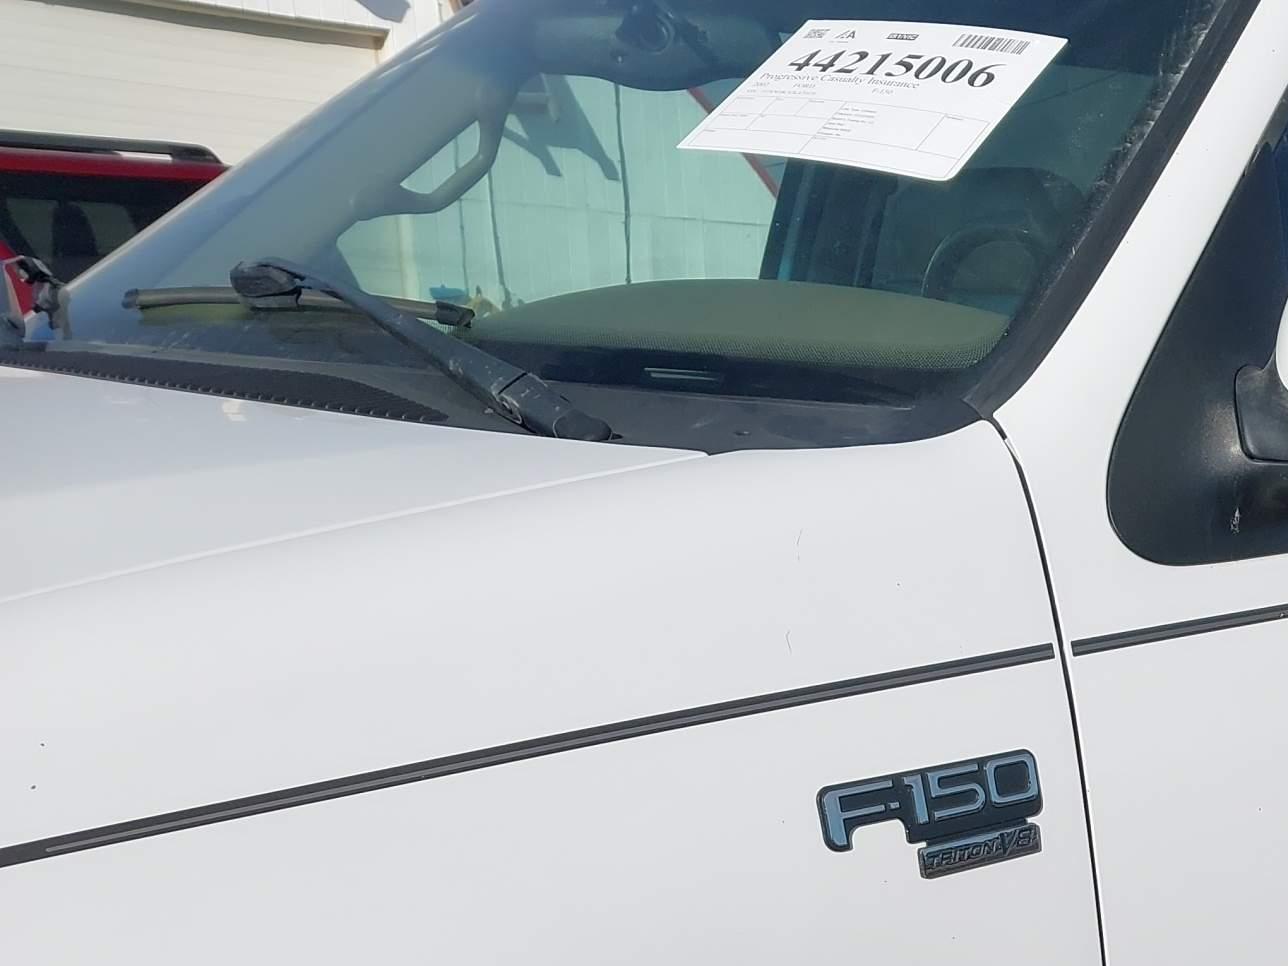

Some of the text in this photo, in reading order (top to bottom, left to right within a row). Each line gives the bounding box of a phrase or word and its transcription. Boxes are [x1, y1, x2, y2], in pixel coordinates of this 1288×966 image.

[759, 72, 920, 89] Progressive Casualty Insurance
[787, 48, 1007, 89] 44215006
[822, 753, 1040, 846] F-150
